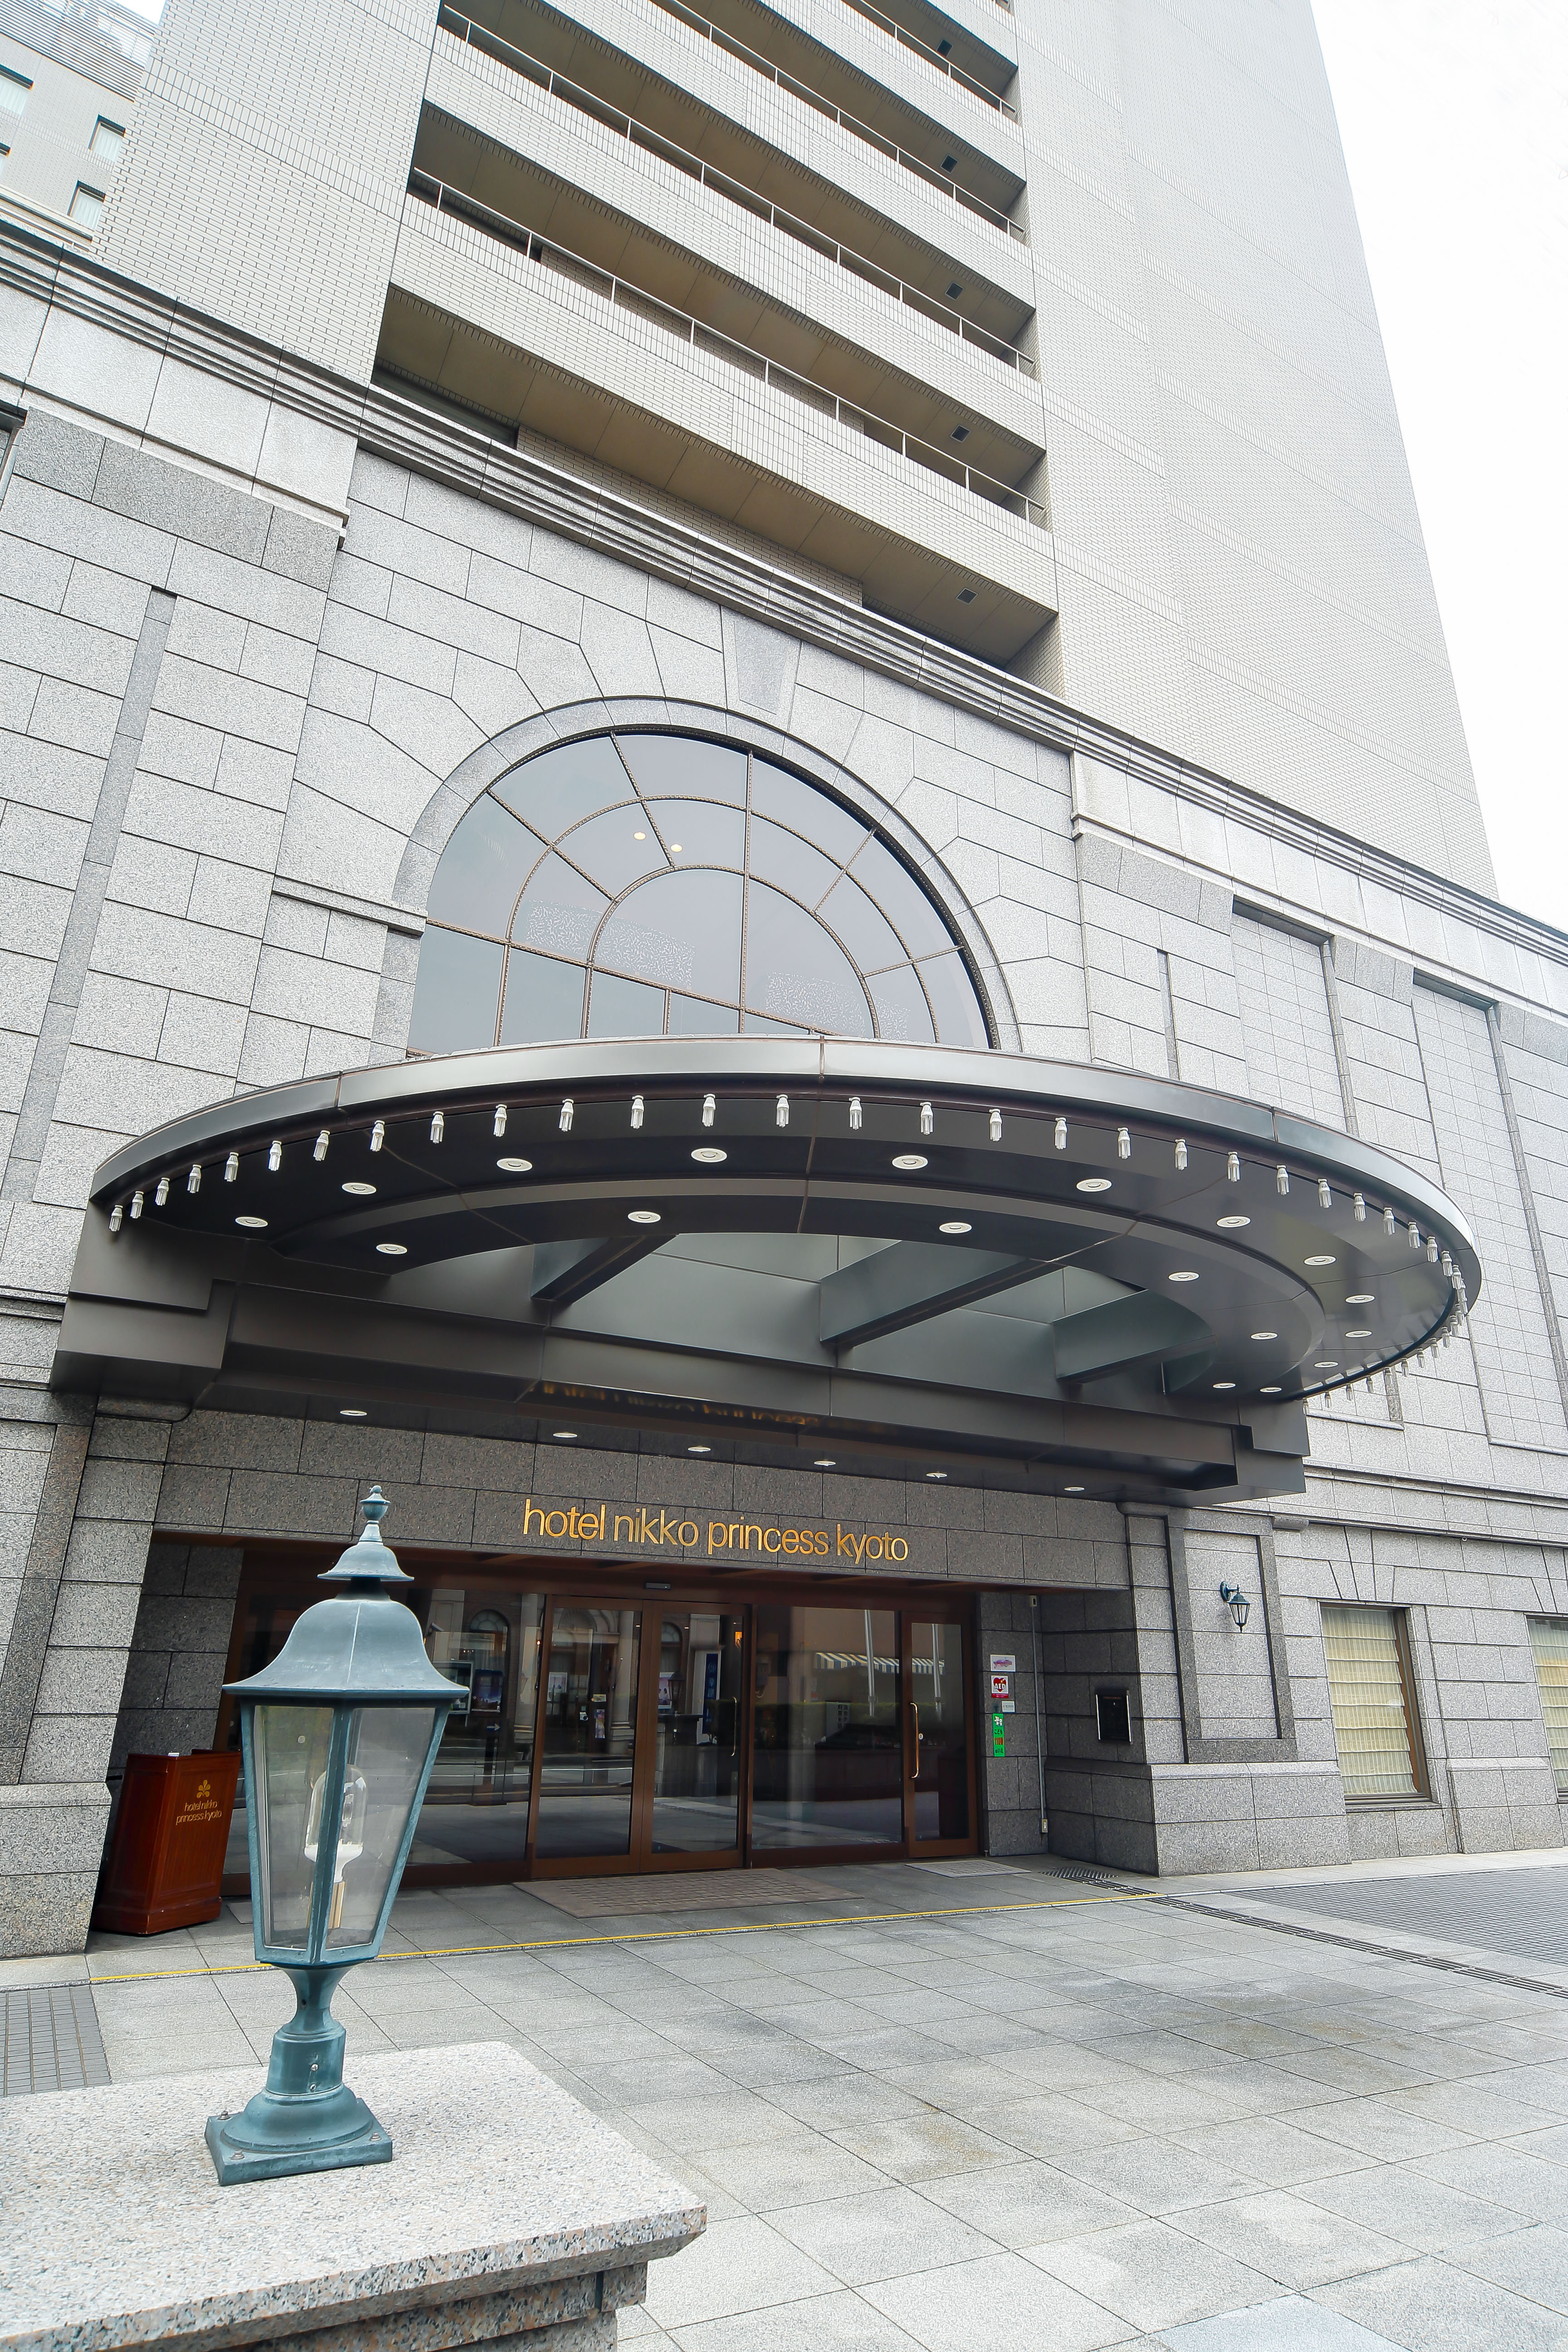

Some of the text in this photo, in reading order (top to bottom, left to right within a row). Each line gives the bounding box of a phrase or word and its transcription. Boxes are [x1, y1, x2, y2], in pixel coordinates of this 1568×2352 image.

[523, 1499, 908, 1563] hotel nikko princess kyoto
[185, 1799, 217, 1811] hotel nikko
[176, 1809, 222, 1825] princess kyoto
